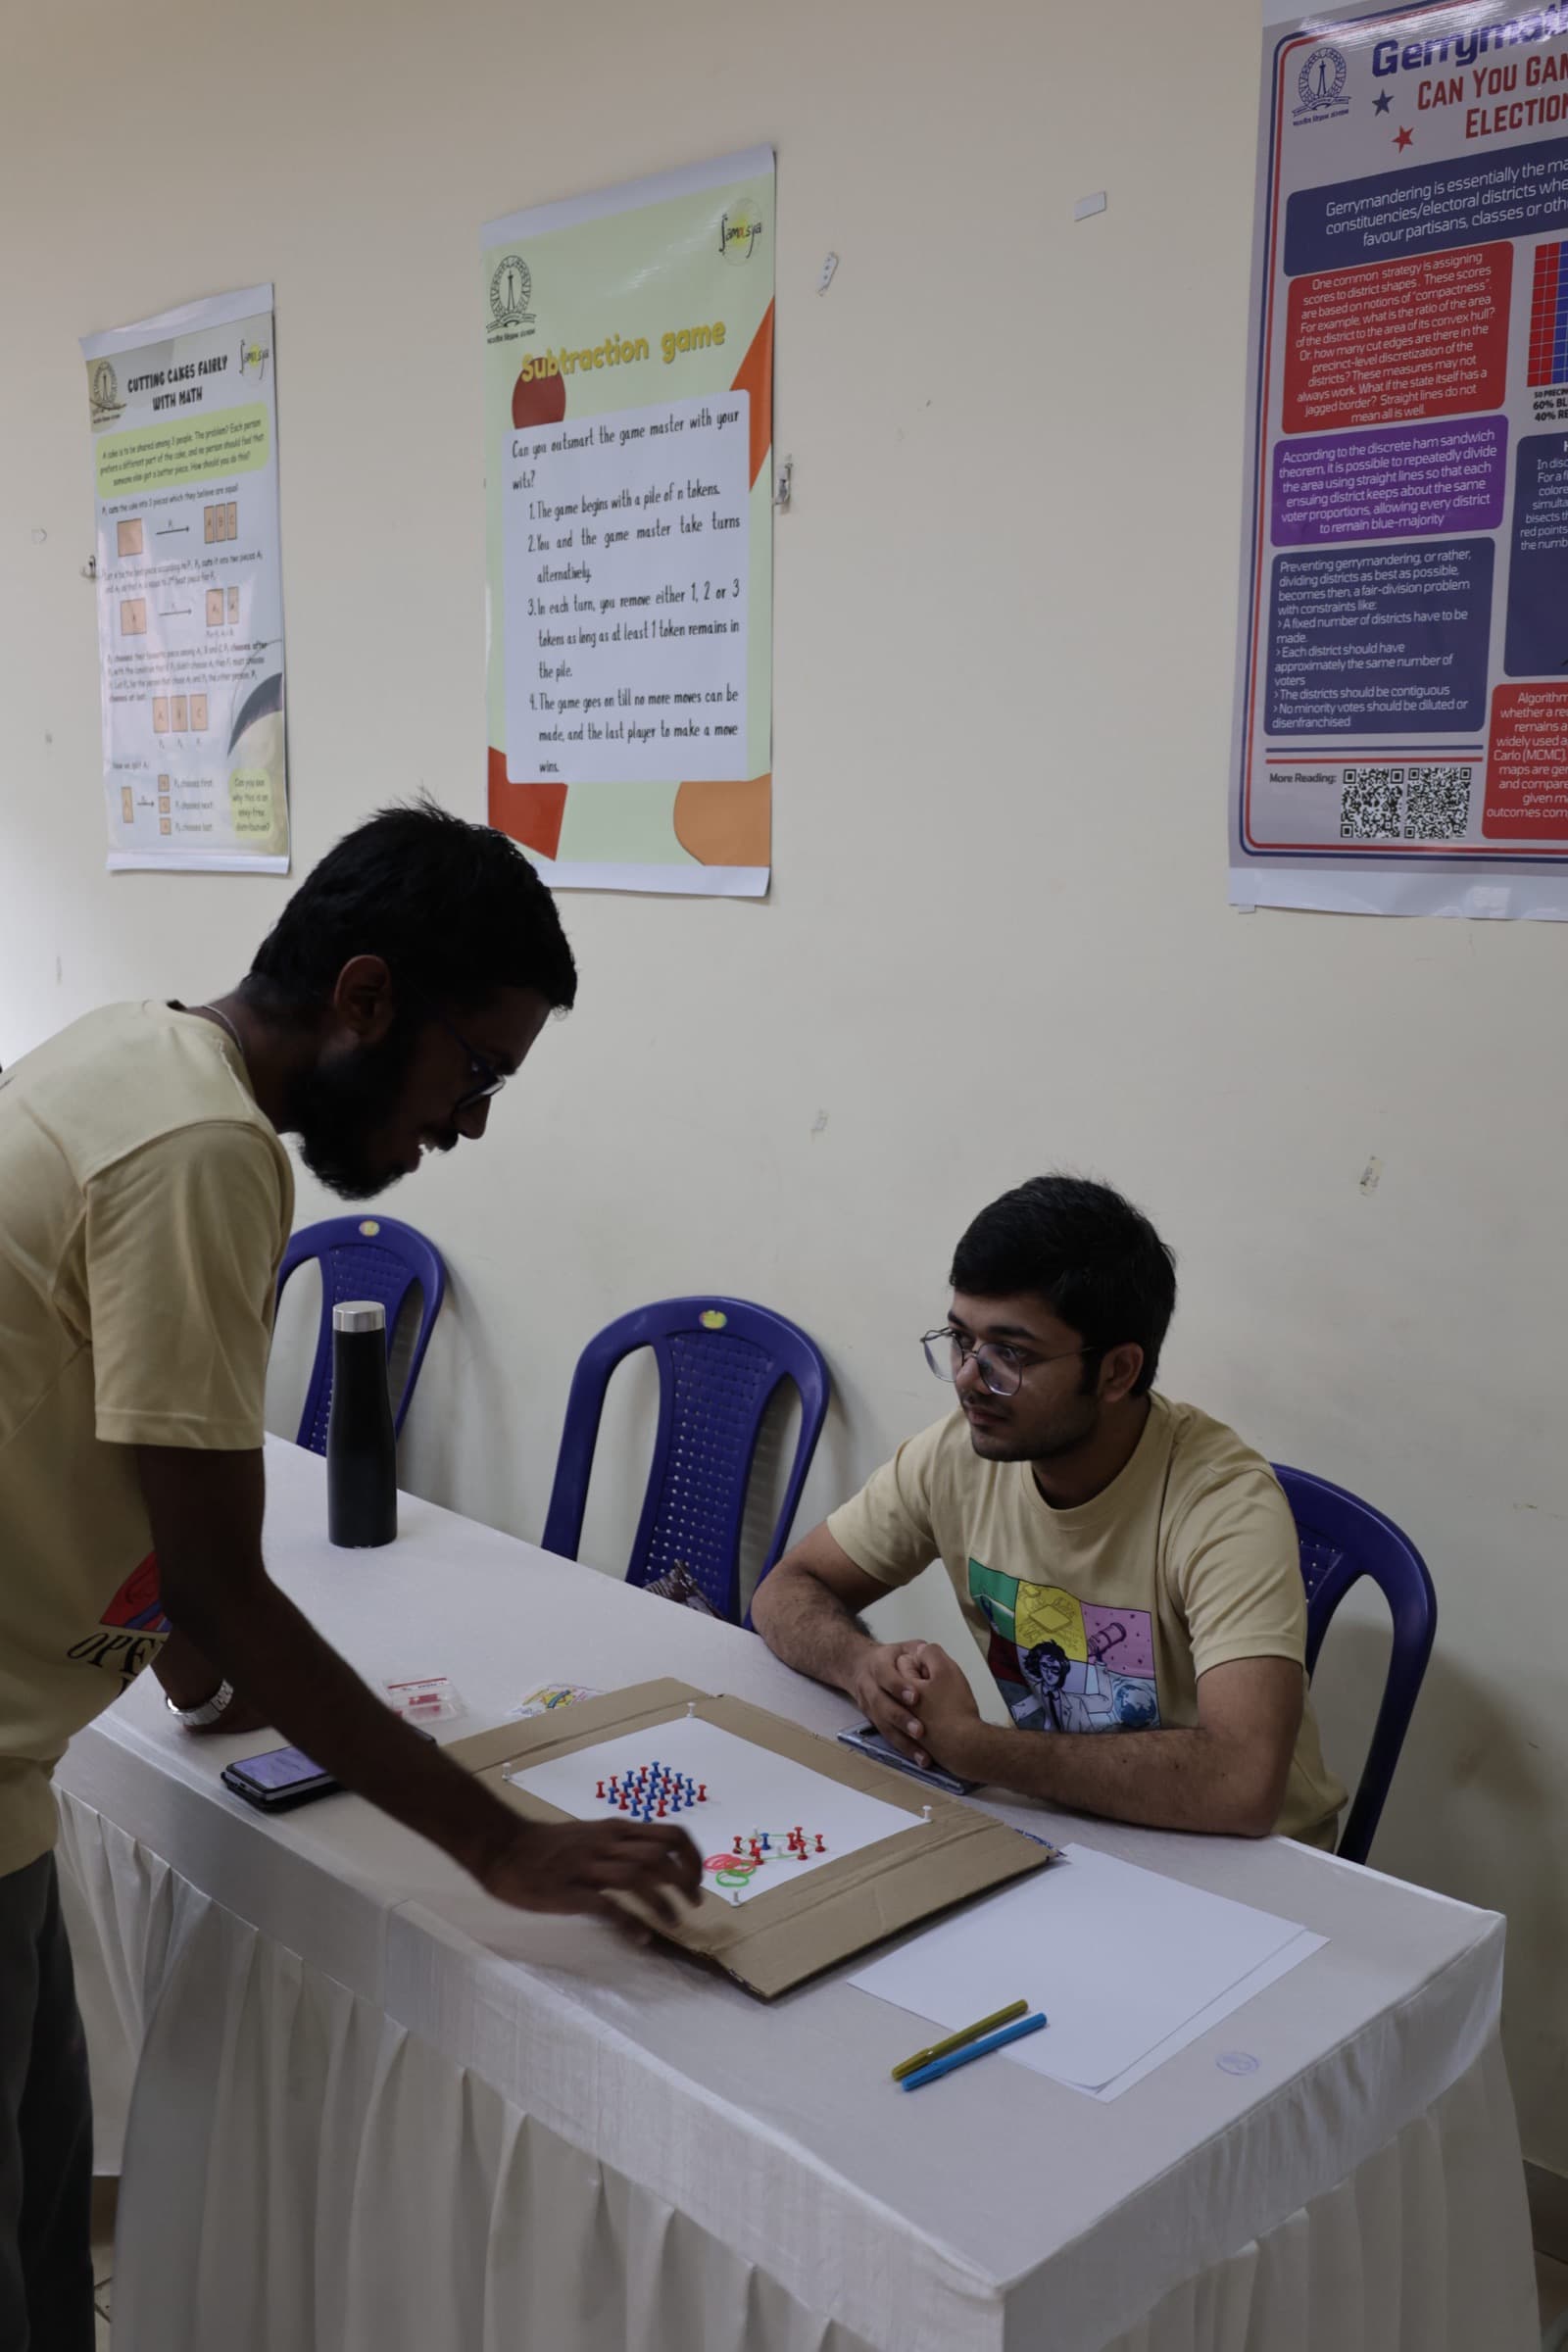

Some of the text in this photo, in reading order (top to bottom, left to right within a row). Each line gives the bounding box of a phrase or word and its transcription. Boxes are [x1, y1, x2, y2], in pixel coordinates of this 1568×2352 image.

[1418, 76, 1463, 110] CAN
[1472, 64, 1517, 98] YOU
[1326, 187, 1432, 218] Gerrymandering
[1434, 183, 1445, 197] is
[1446, 169, 1520, 195] essentially
[1522, 165, 1544, 180] the
[1326, 194, 1479, 235] constituencies/electoral
[1482, 186, 1536, 208] districts
[1363, 228, 1404, 247] favour
[1405, 218, 1468, 243] partisans,
[1472, 207, 1524, 226] classes
[1526, 204, 1542, 217] or
[520, 320, 726, 383] Subtraction game
[127, 374, 165, 393] CUTTING
[168, 364, 195, 384] CAKES
[198, 355, 227, 376] FAIRLY
[153, 386, 203, 412] WITH MATH
[512, 410, 739, 460] Can you outsmart the game master with your
[1283, 429, 1494, 464] According to the discrete ham sandwich
[1327, 462, 1333, 473] it
[1335, 461, 1344, 472] is
[1346, 457, 1390, 474] possible
[1392, 456, 1402, 467] to
[1404, 450, 1461, 467] repeatedly
[1463, 446, 1497, 461] divide
[513, 468, 535, 489] wits?
[1283, 462, 1492, 492] the area using straight lines so that each
[555, 502, 578, 520] game
[581, 495, 608, 516] begins
[611, 488, 632, 509] with
[634, 494, 640, 506] a
[644, 485, 661, 510] pile
[663, 482, 674, 502] of
[677, 488, 683, 500] n
[687, 479, 720, 499] tokens.
[1281, 510, 1307, 521] voter
[1373, 500, 1418, 514] allowing
[1420, 499, 1451, 512] every
[1452, 494, 1490, 508] district
[1286, 481, 1486, 507] ensuing district keeps about the same
[557, 530, 572, 549] and
[581, 528, 597, 547] the
[604, 530, 629, 549] game
[636, 520, 671, 540] master
[680, 515, 703, 536] take
[711, 514, 740, 532] turns
[1319, 514, 1445, 534] to remain blue-majority
[537, 562, 592, 583] alternatively.
[549, 595, 568, 613] each
[573, 594, 595, 612] turn,
[600, 597, 615, 614] you
[619, 594, 651, 608] remove
[656, 585, 685, 605] either
[691, 584, 698, 603] 1,
[704, 582, 710, 601] 2
[715, 587, 726, 600] or
[732, 579, 740, 598] 3
[538, 618, 739, 648] tokens as long as at least 1 token remains in
[1283, 617, 1291, 628] A
[1317, 613, 1358, 627] number
[1358, 612, 1370, 625] of
[1371, 612, 1412, 624] districts
[1413, 611, 1441, 622] have
[1442, 611, 1452, 621] to
[1453, 609, 1468, 620] be
[1282, 642, 1405, 658] Each district should have
[539, 660, 572, 683] the pile.
[558, 698, 580, 714] game
[583, 697, 601, 713] goes
[604, 696, 614, 708] on
[617, 689, 631, 707] till
[634, 694, 645, 707] no
[648, 693, 670, 706] more
[674, 691, 702, 705] moves
[705, 690, 722, 703] can
[726, 683, 738, 702] be
[539, 718, 738, 744] made, and the last player to make a move
[539, 760, 560, 773] wins.
[1269, 772, 1337, 785] More Reading:
[67, 1633, 164, 1676] OPE
